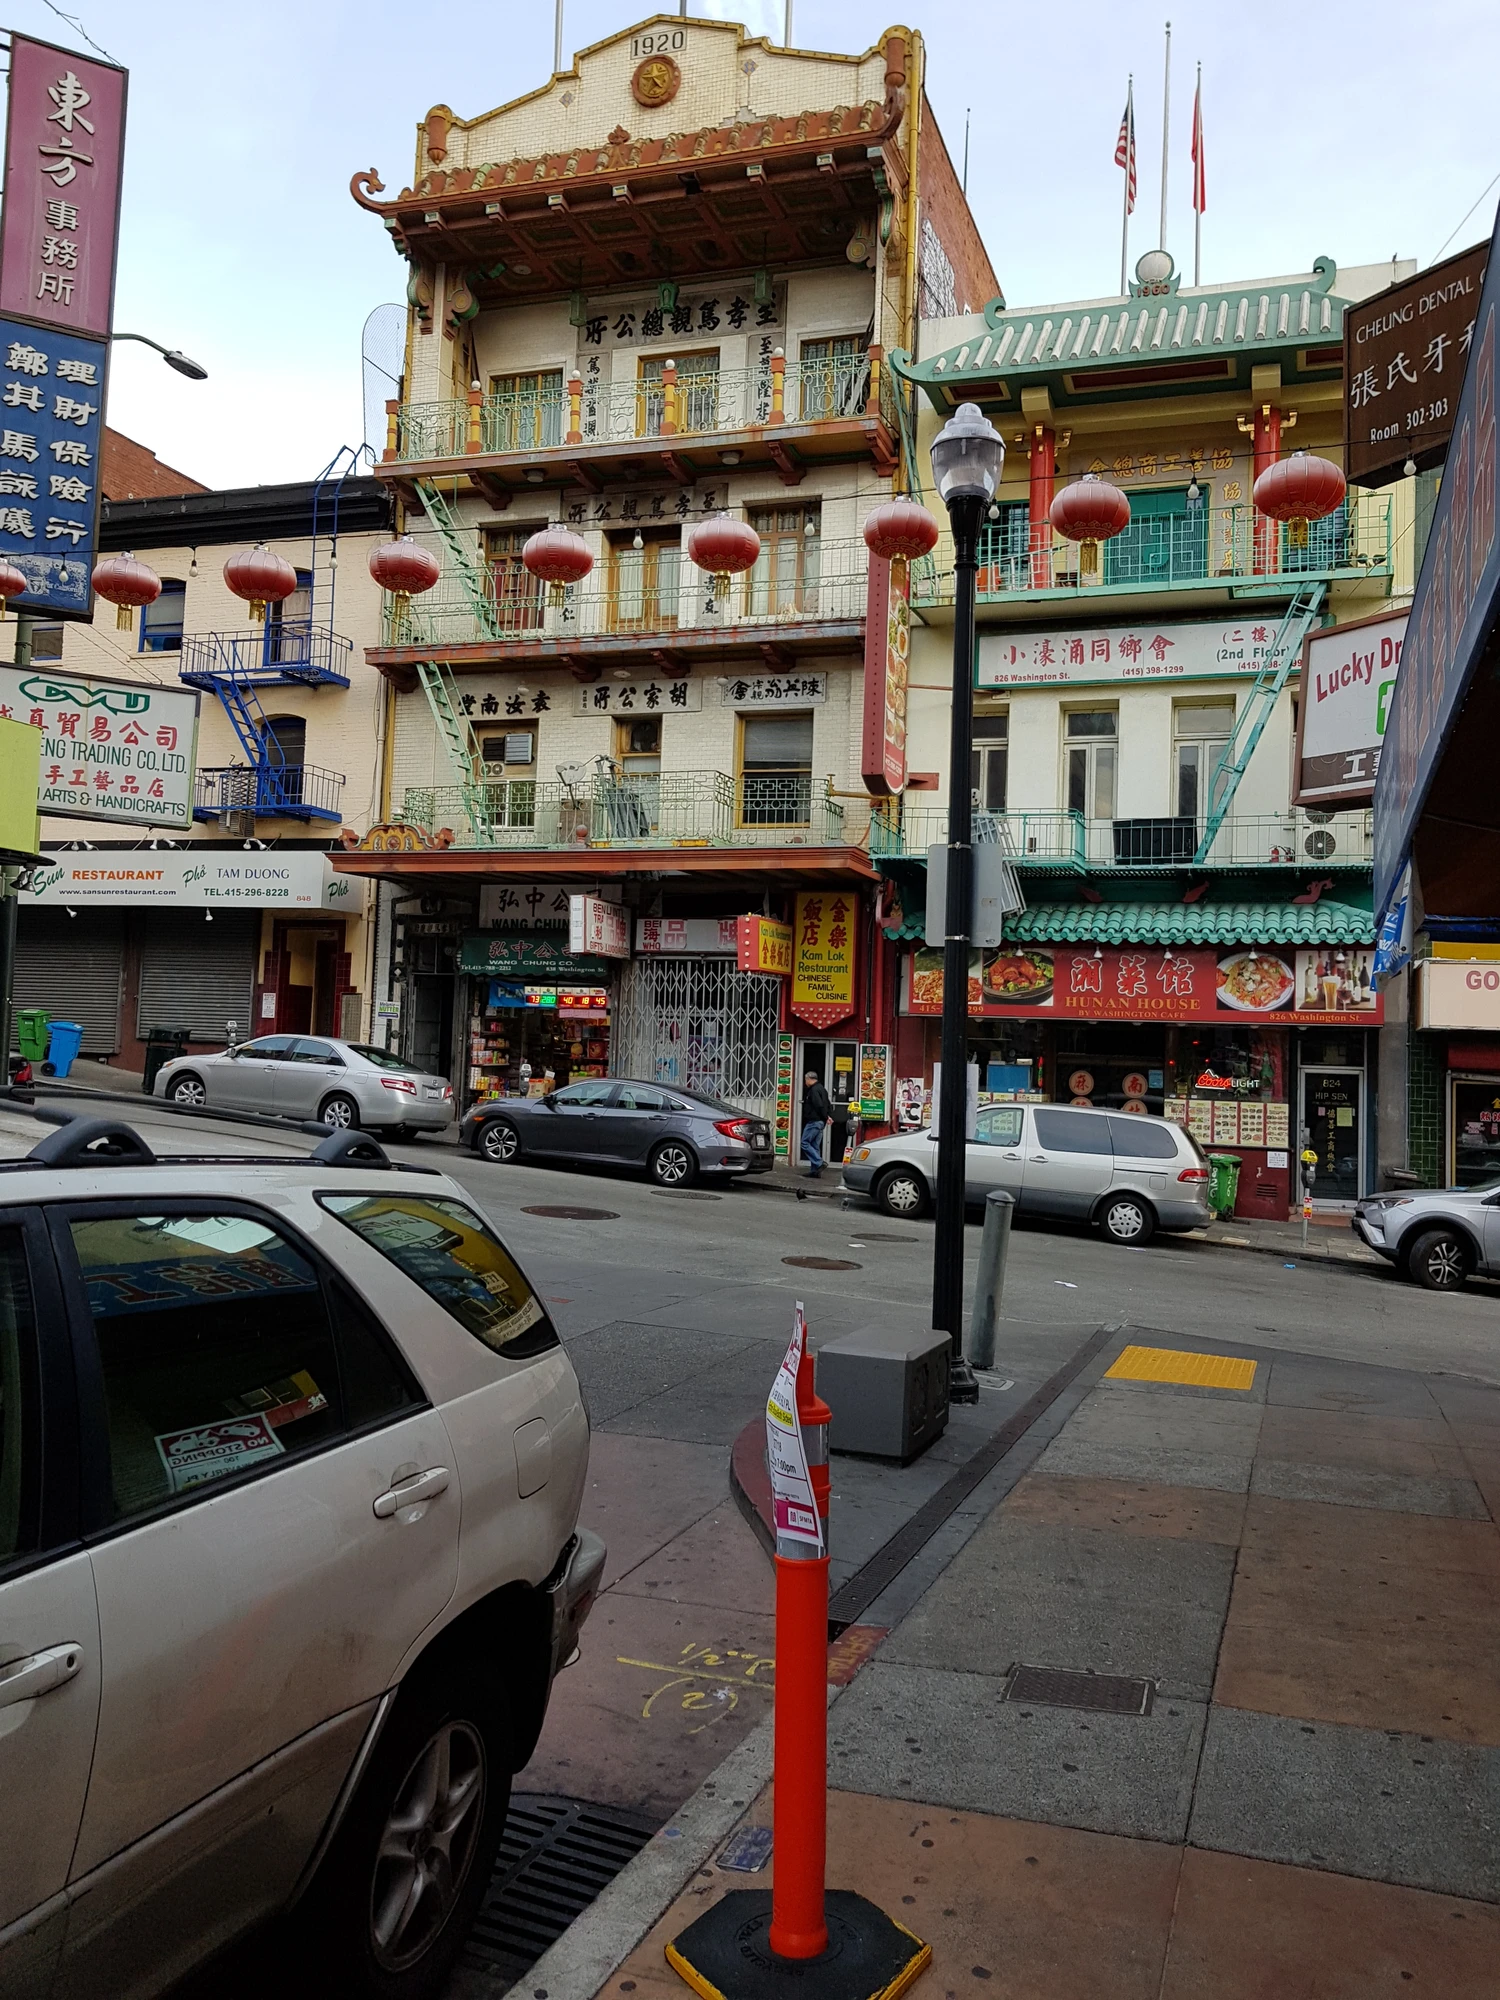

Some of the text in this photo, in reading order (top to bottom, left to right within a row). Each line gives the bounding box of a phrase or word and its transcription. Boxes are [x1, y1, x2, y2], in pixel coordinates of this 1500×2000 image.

[633, 31, 684, 57] 1920
[1137, 284, 1170, 298] 1960
[1356, 276, 1474, 344] CHEUNG DENTAL
[1370, 423, 1399, 444] Room
[45, 359, 99, 545] 理財保險行
[1122, 665, 1185, 677] (415) 398-1299
[1238, 660, 1260, 671] (415)
[994, 672, 1071, 684] 826 Washington St.
[1316, 651, 1376, 703] Lucky
[70, 741, 131, 767] TRADING
[43, 787, 77, 804] ARTS
[96, 794, 186, 816] HANDICRAFTS
[34, 868, 65, 896] Sun
[72, 870, 164, 880] RESTAURANT
[217, 868, 240, 879] TAM
[245, 868, 290, 879] DUONG
[801, 949, 844, 961] Kam Lok
[798, 961, 848, 973] Restaurant
[798, 974, 832, 983] CHINESE
[808, 983, 835, 991] FAMILY
[595, 997, 606, 1005] 45
[816, 992, 848, 1000] CUISINE
[1065, 996, 1200, 1010] HUNAN HOUSE
[1094, 1010, 1157, 1018] WASHINGTON
[1269, 1012, 1362, 1023] 826 Washington St.
[1198, 1074, 1260, 1088] Coors LIGHT
[1323, 1079, 1341, 1087] 824
[1315, 1092, 1329, 1100] HIP
